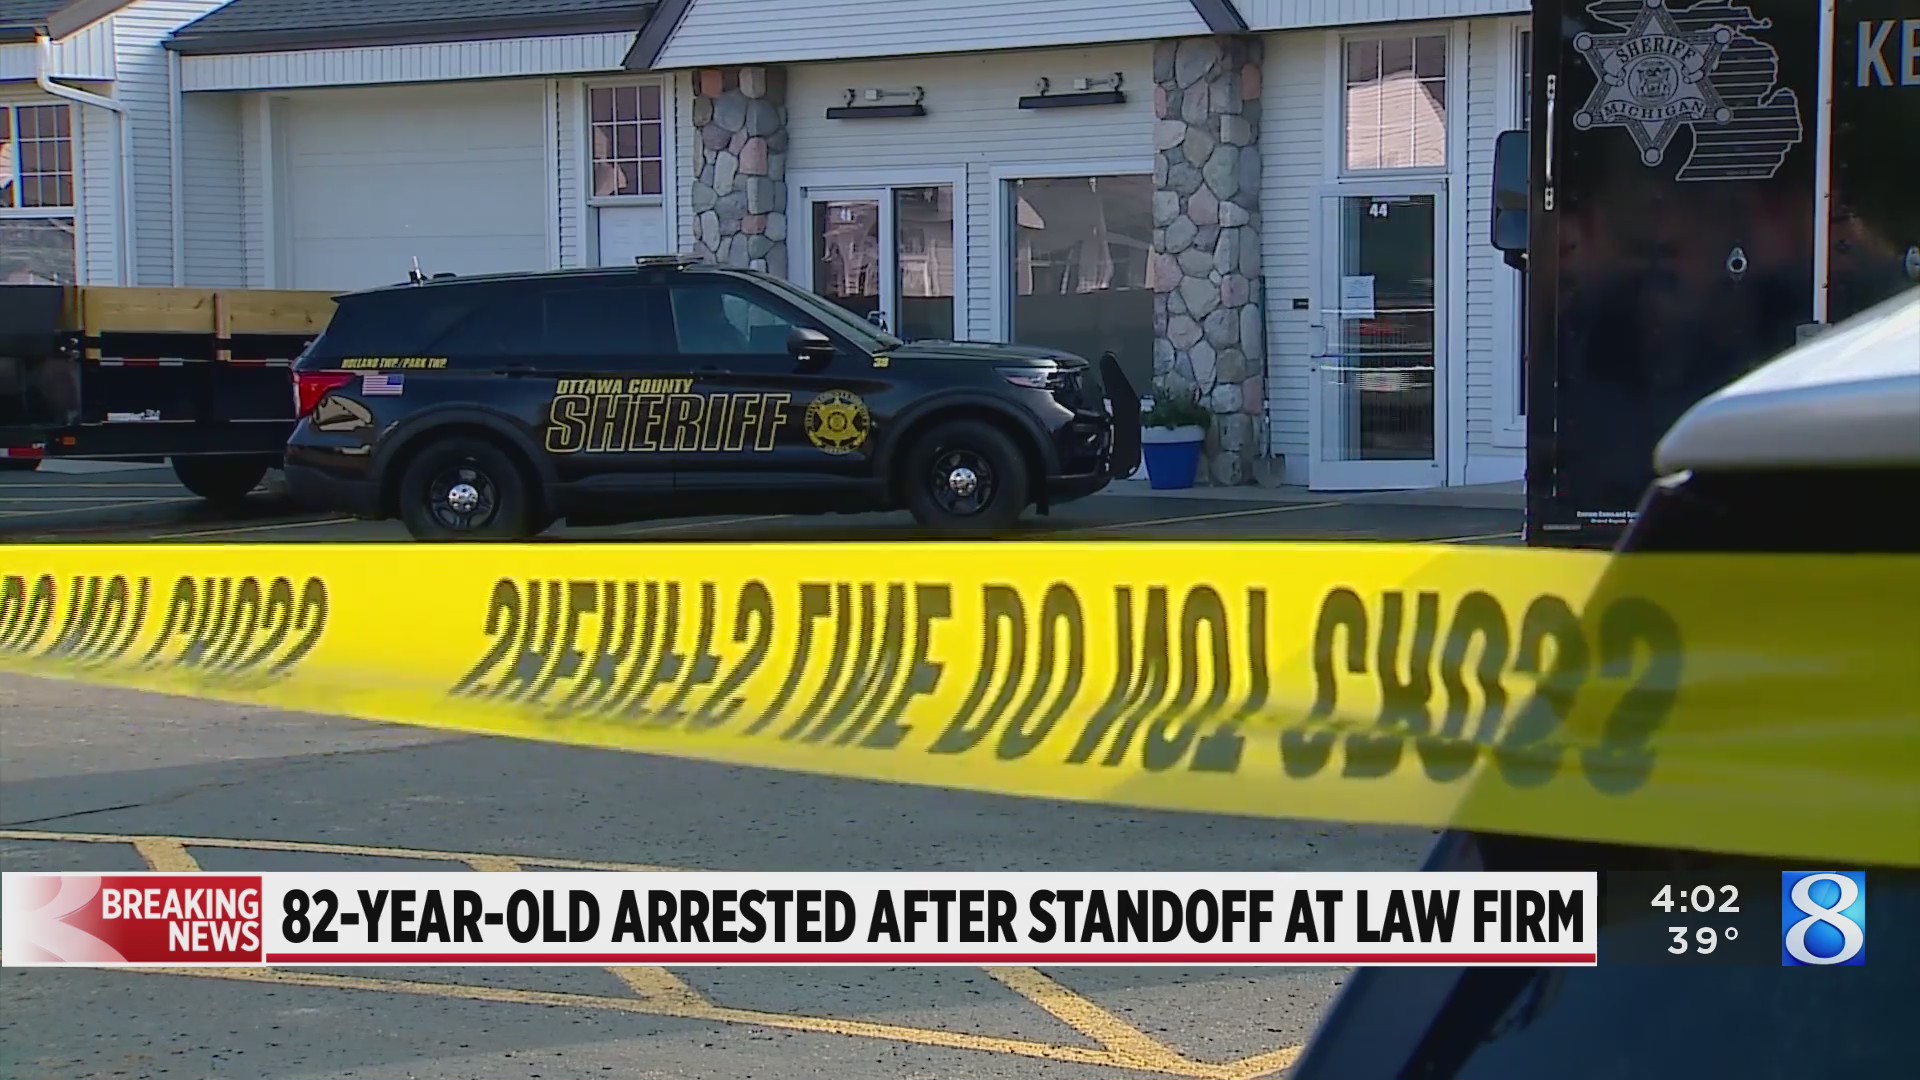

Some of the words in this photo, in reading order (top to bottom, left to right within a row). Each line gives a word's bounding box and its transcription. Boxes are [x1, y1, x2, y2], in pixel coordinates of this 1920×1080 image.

[1616, 37, 1696, 63] SHERIFF
[1604, 101, 1704, 119] MICHIGAN
[1369, 203, 1388, 218] 44
[556, 379, 622, 395] OTTAWA
[627, 379, 694, 394] COUNTY
[545, 393, 792, 453] SHERIFF
